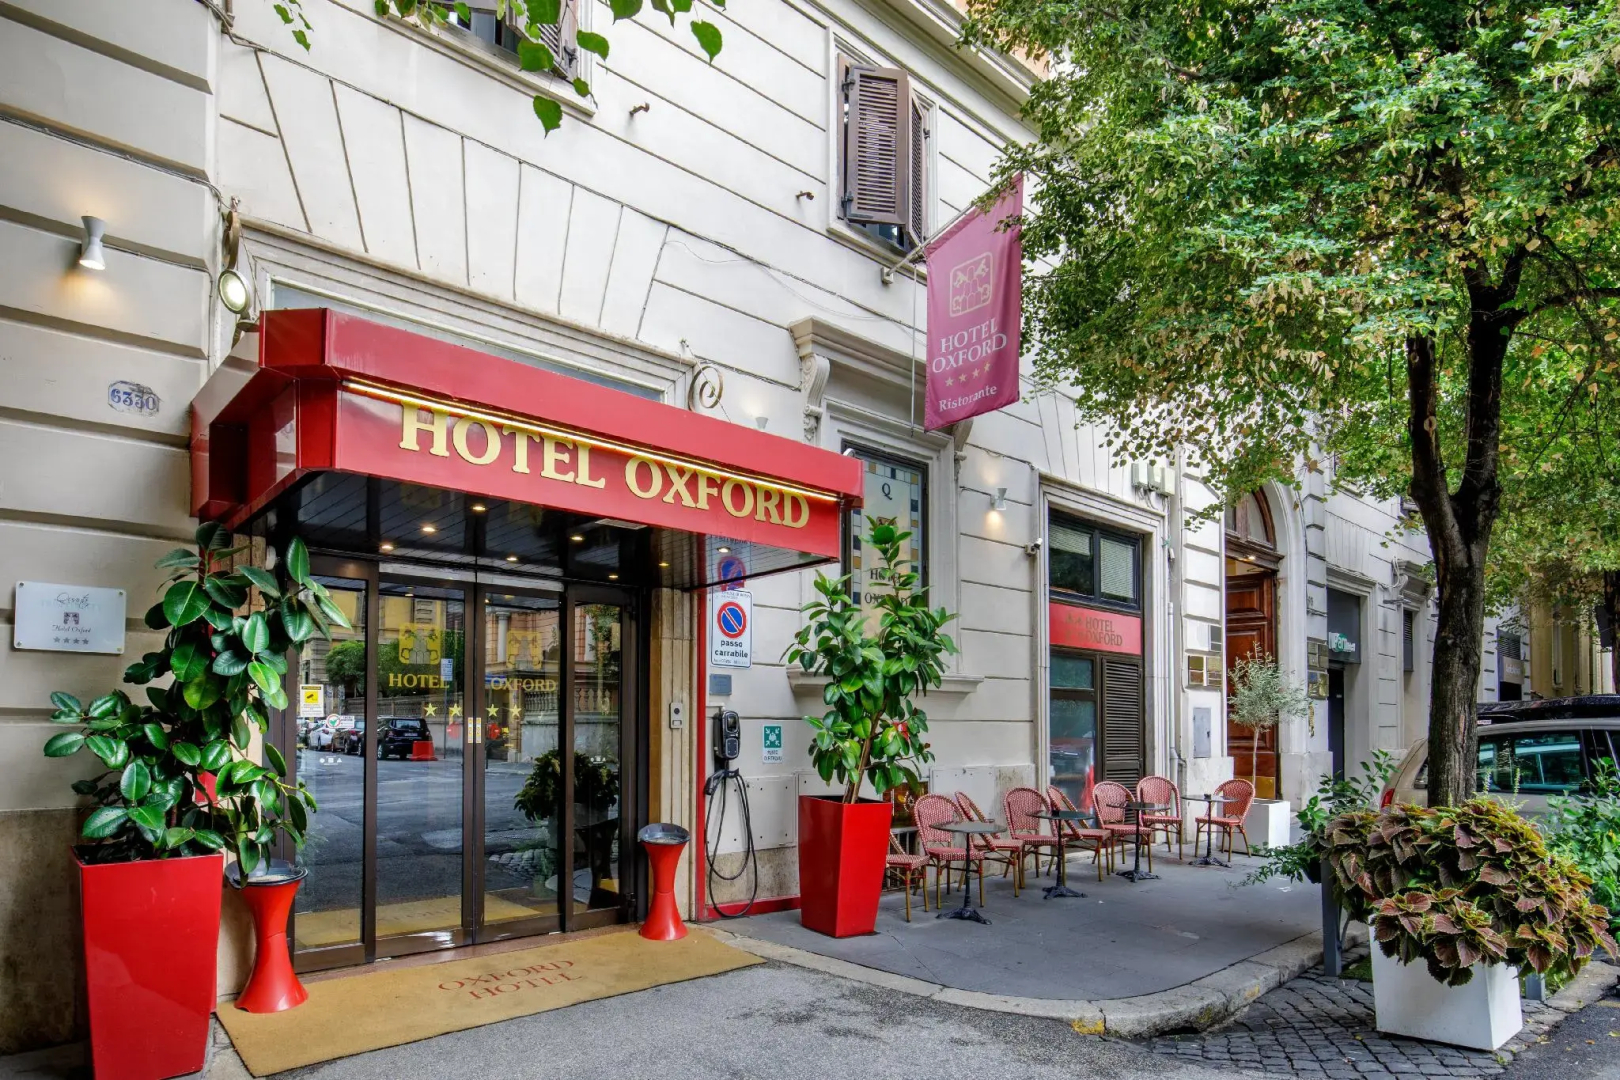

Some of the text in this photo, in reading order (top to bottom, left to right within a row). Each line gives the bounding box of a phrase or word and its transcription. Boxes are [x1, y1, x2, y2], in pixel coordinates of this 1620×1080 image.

[940, 318, 998, 353] HOTEL
[932, 333, 1007, 373] OXFORD
[938, 384, 998, 412] Ristorante
[399, 402, 811, 529] HOTEL OXFORD
[881, 482, 893, 501] Q
[1085, 615, 1115, 633] HOTEL
[720, 640, 743, 648] passo
[1086, 630, 1123, 647] OXFORD
[714, 649, 749, 659] carrabile
[388, 672, 557, 692] HOTEL OXFORD
[438, 960, 575, 991] OXFORD
[468, 972, 583, 1000] HOTEL
